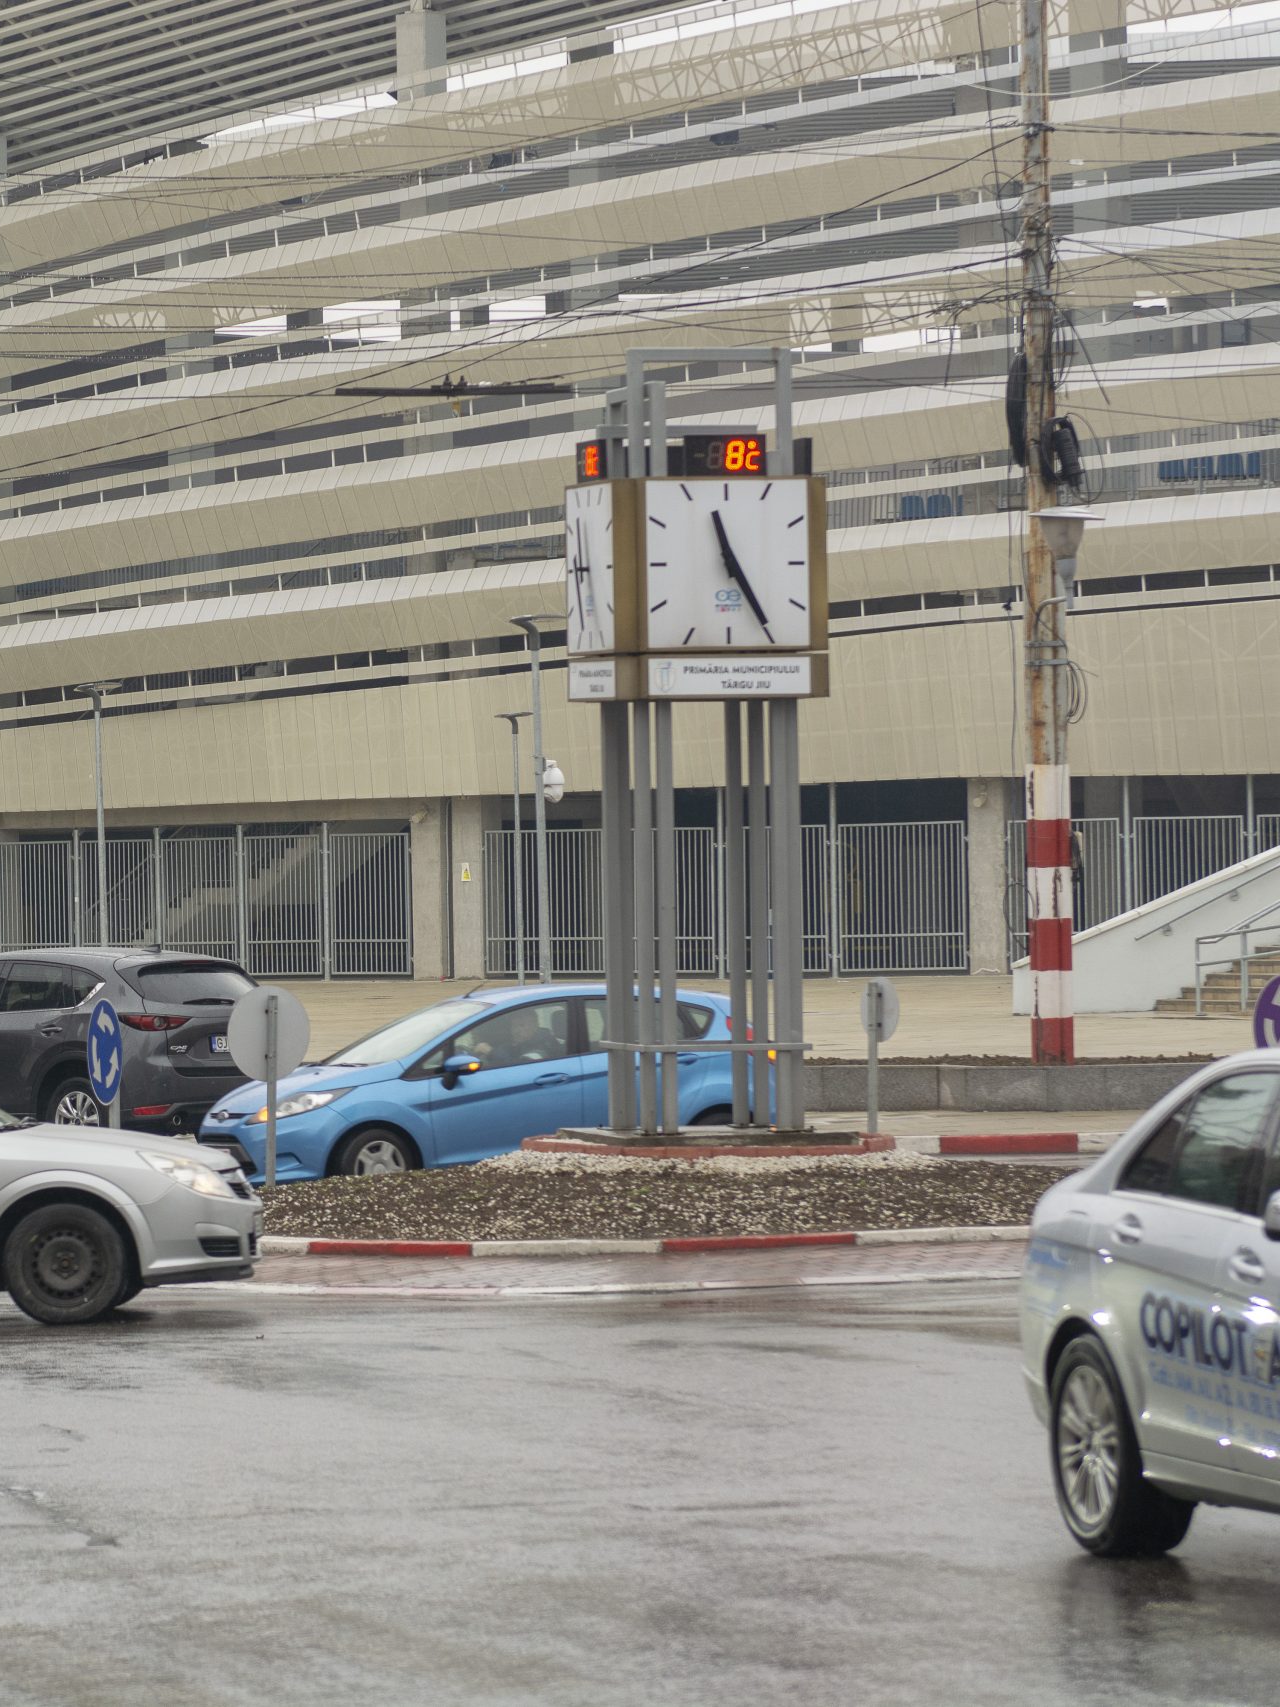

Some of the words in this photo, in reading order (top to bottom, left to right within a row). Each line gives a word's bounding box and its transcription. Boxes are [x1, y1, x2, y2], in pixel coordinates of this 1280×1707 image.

[732, 665, 801, 674] MUNICIPIULUI
[757, 680, 771, 689] JIU
[1140, 1291, 1248, 1376] COPILOT
